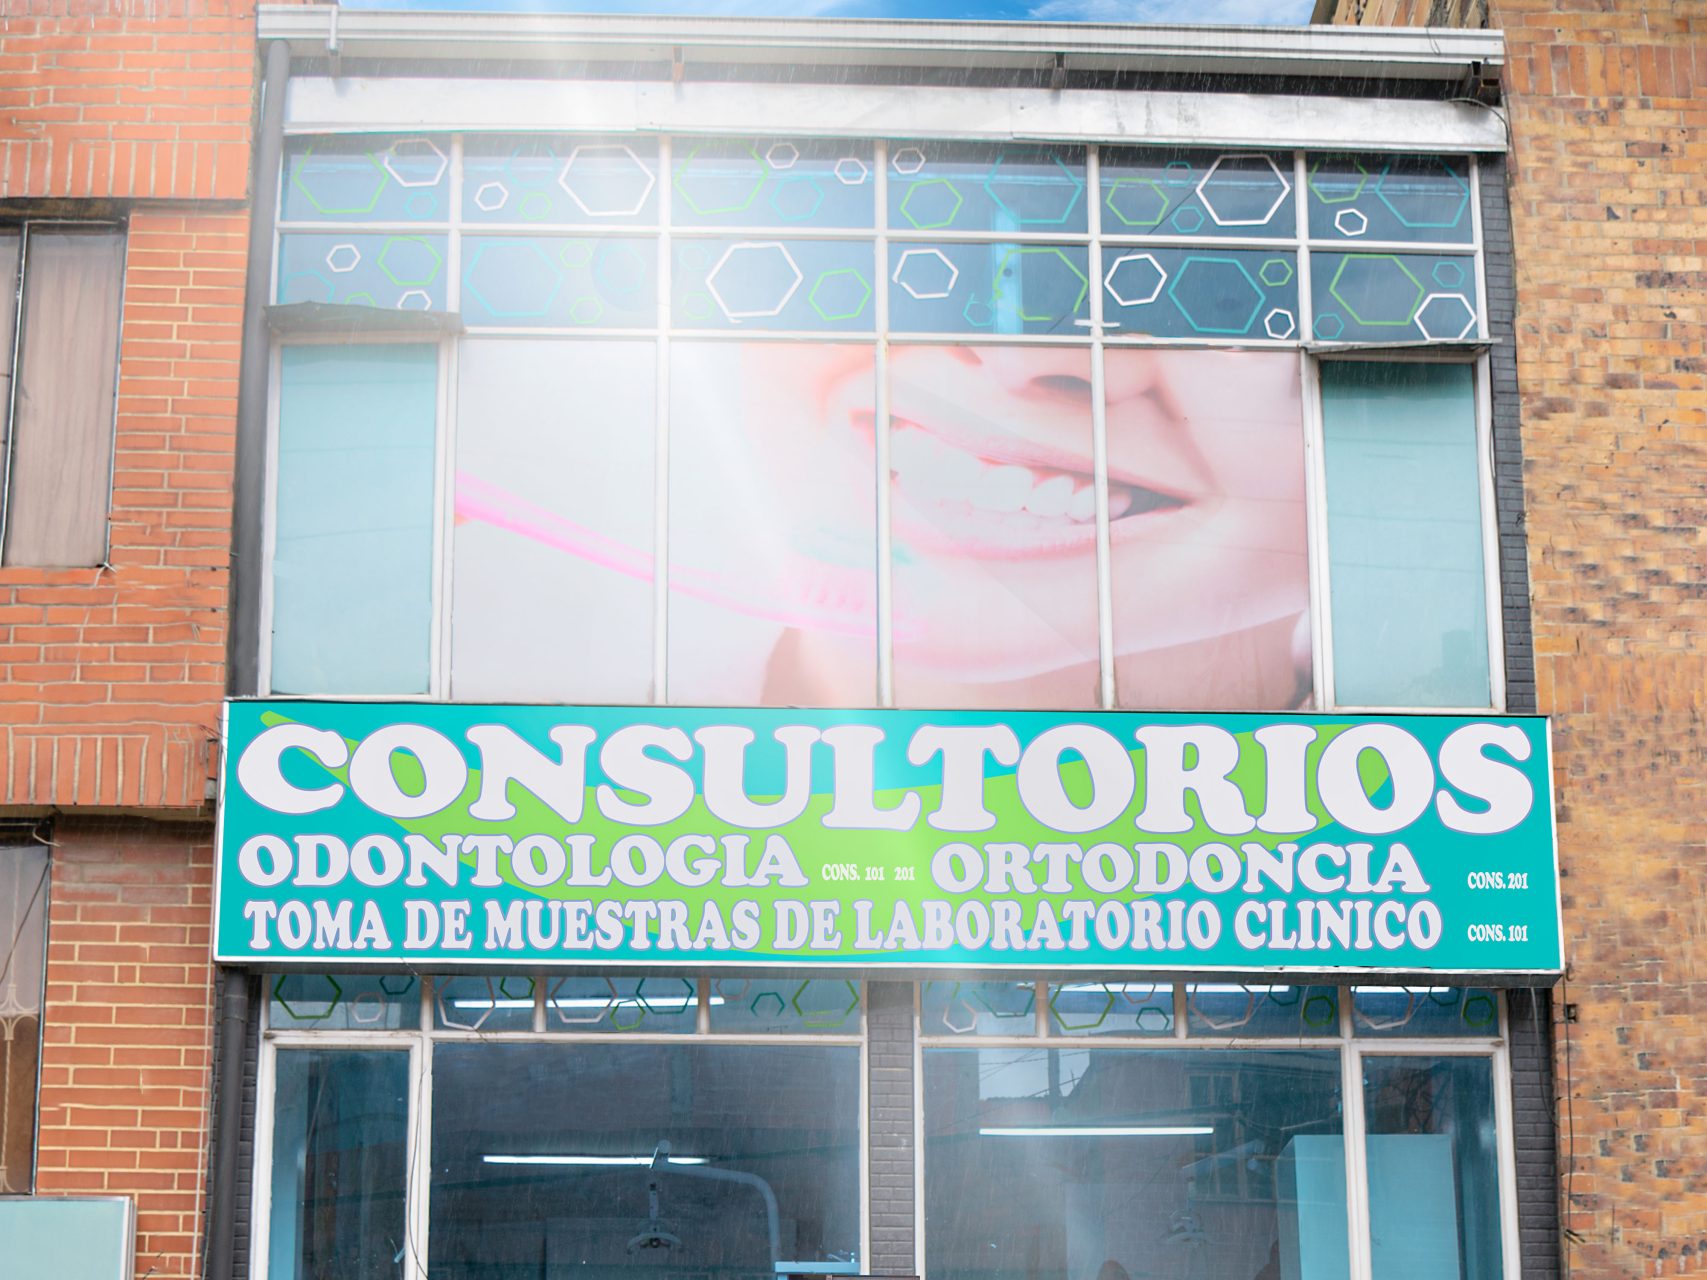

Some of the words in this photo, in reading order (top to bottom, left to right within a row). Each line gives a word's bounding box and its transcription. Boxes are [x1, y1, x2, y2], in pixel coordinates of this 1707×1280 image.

[236, 721, 1534, 836] CONSULTORIOS
[238, 832, 809, 889] ODONTOLOGIA
[821, 863, 861, 881] CONS.
[864, 866, 885, 881] 101
[894, 866, 916, 881] 201
[930, 841, 1431, 894] ORTODONCIA
[1467, 871, 1506, 889] CONS.
[1507, 872, 1529, 889] 201
[243, 899, 393, 951] TOMA
[403, 899, 473, 950] DE
[483, 899, 763, 952] MUESTRAS
[771, 898, 843, 951] DE
[852, 898, 1223, 952] LABORATORIO
[1234, 899, 1443, 951] CLINICO
[1467, 924, 1506, 941] CONS.
[1507, 925, 1529, 942] 101
